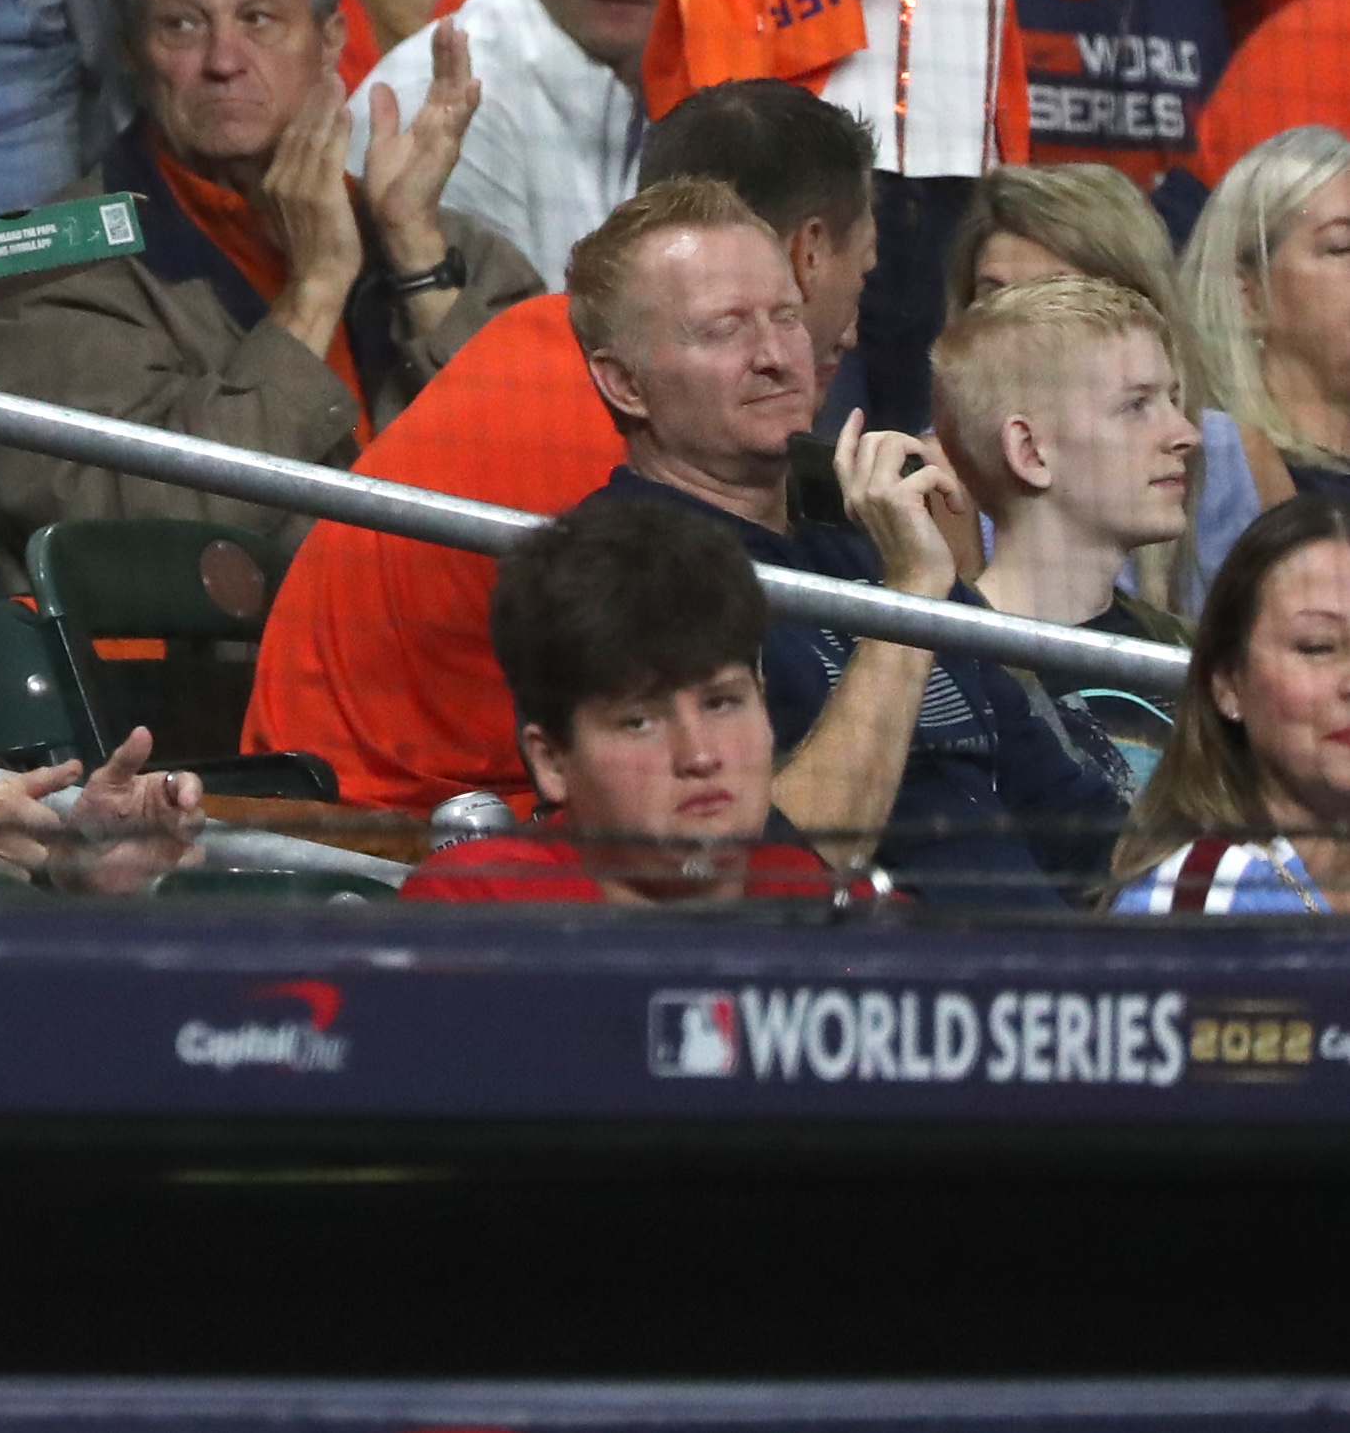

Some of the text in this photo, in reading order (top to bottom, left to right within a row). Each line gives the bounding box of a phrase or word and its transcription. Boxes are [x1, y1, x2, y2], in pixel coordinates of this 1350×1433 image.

[739, 987, 1313, 1088] WORLD SERIES 2022
